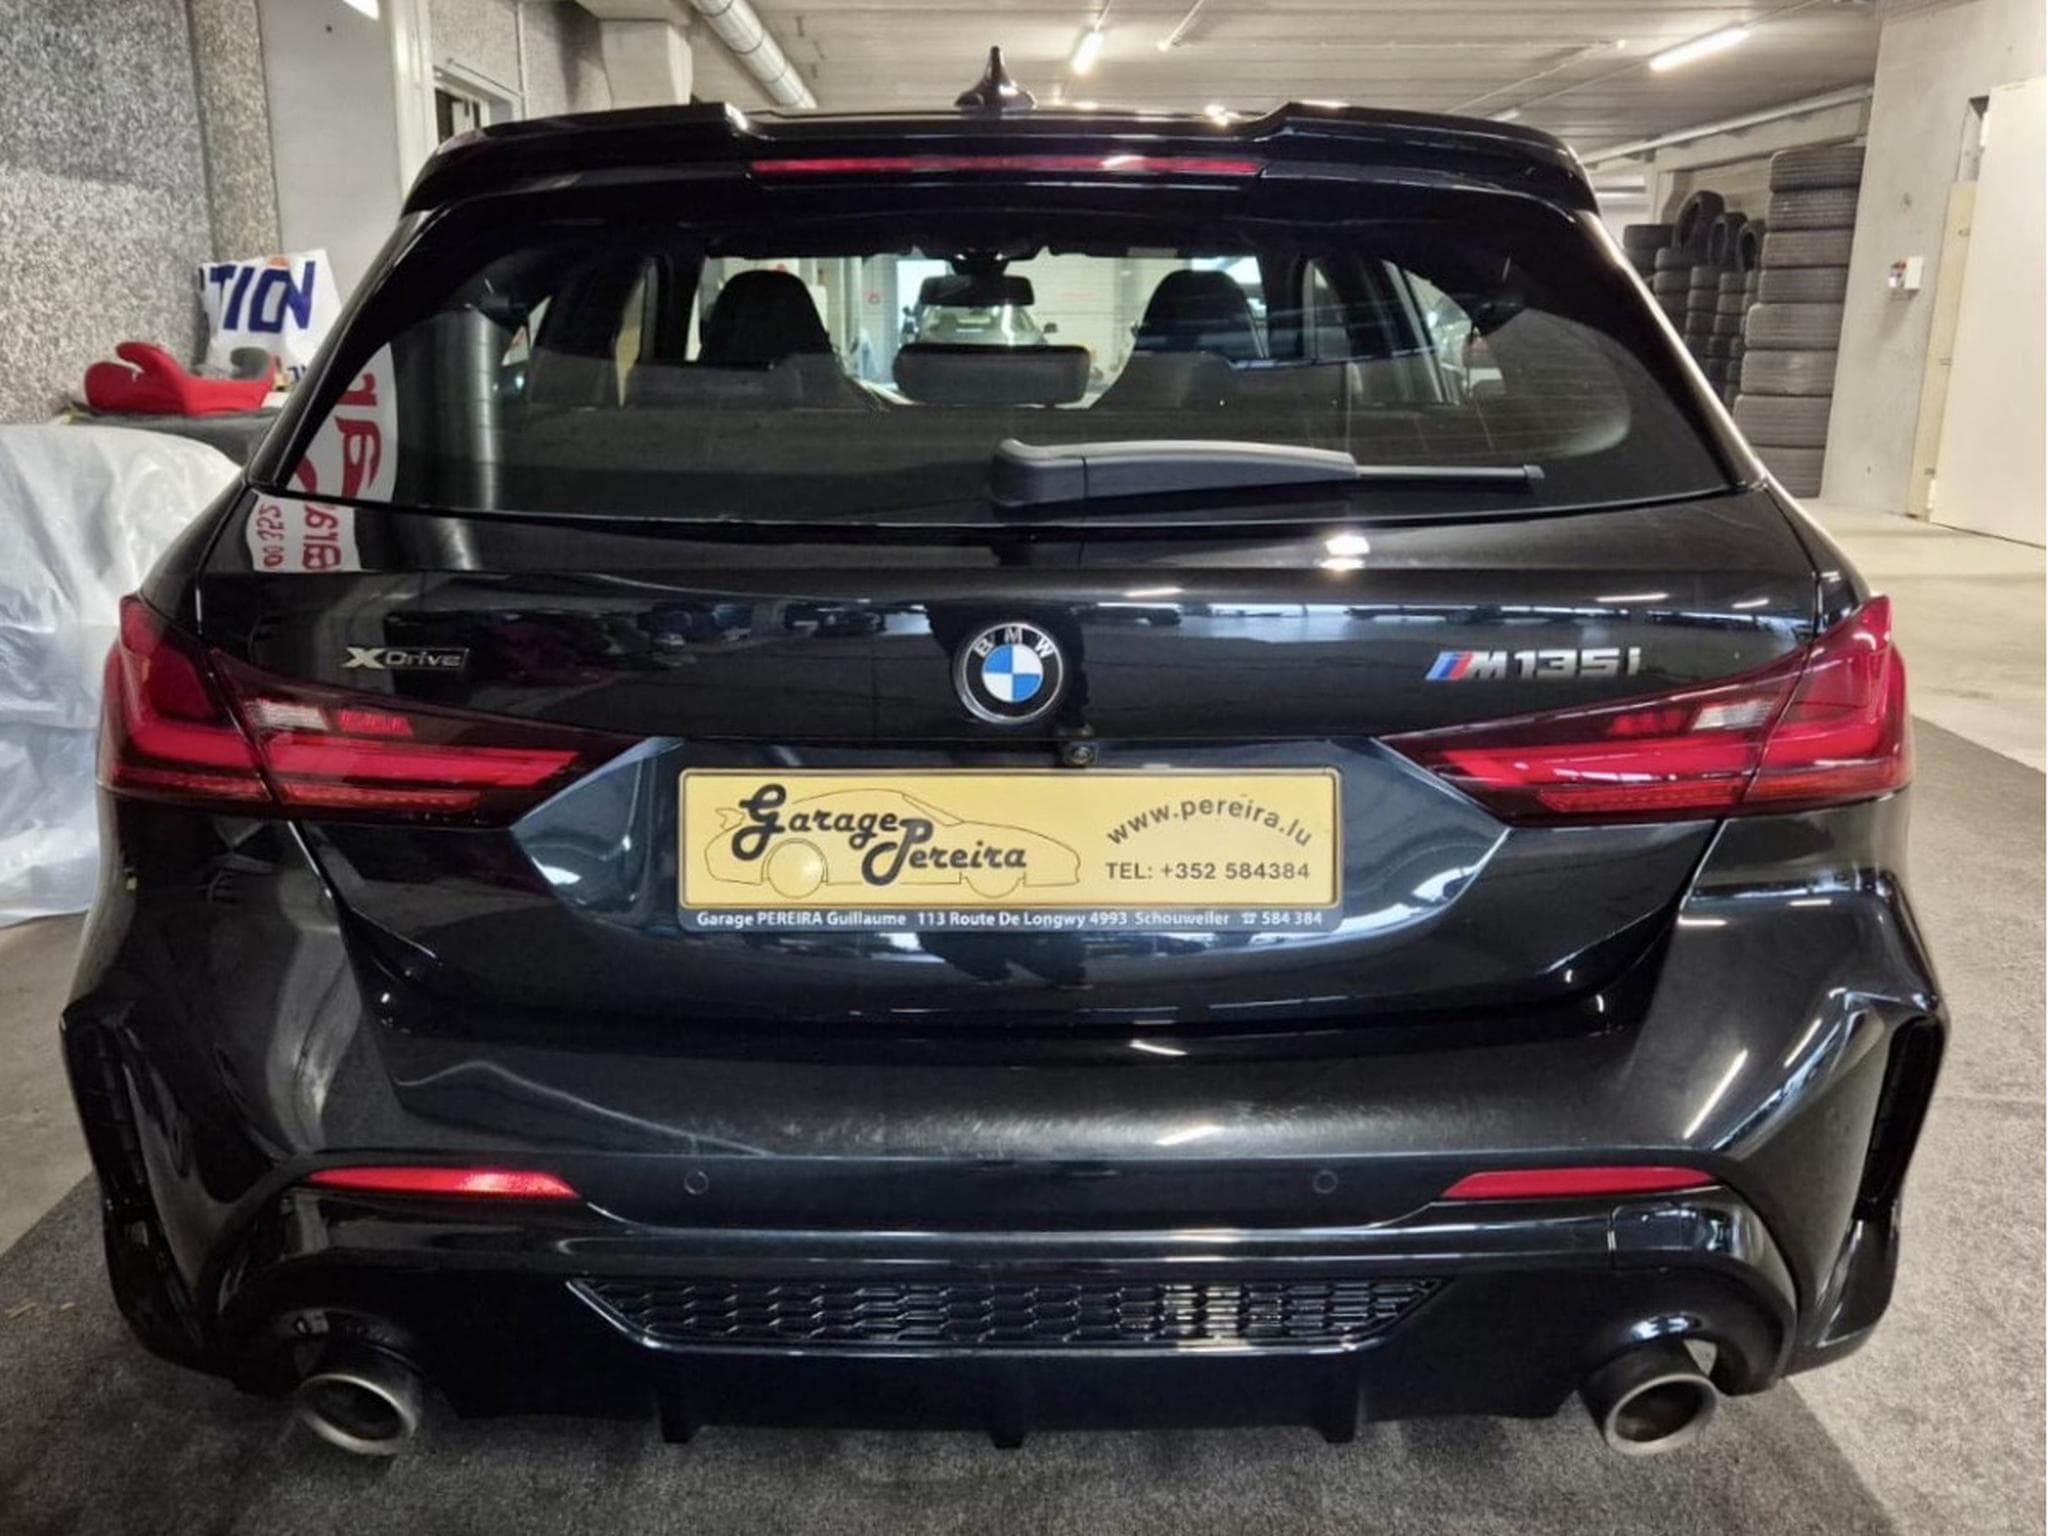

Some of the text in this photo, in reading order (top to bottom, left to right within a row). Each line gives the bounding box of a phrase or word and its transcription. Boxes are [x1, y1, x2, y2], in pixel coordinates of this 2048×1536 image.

[731, 783, 899, 861] Garage
[1107, 797, 1312, 847] www.pereira.lu
[861, 818, 1027, 886] Pereira
[1106, 862, 1310, 880] TEL: +352 584384
[696, 910, 1323, 929] Garage PEREIRA Guillaume 113 Route De Longwy 4993 Schouweiler 584 384
